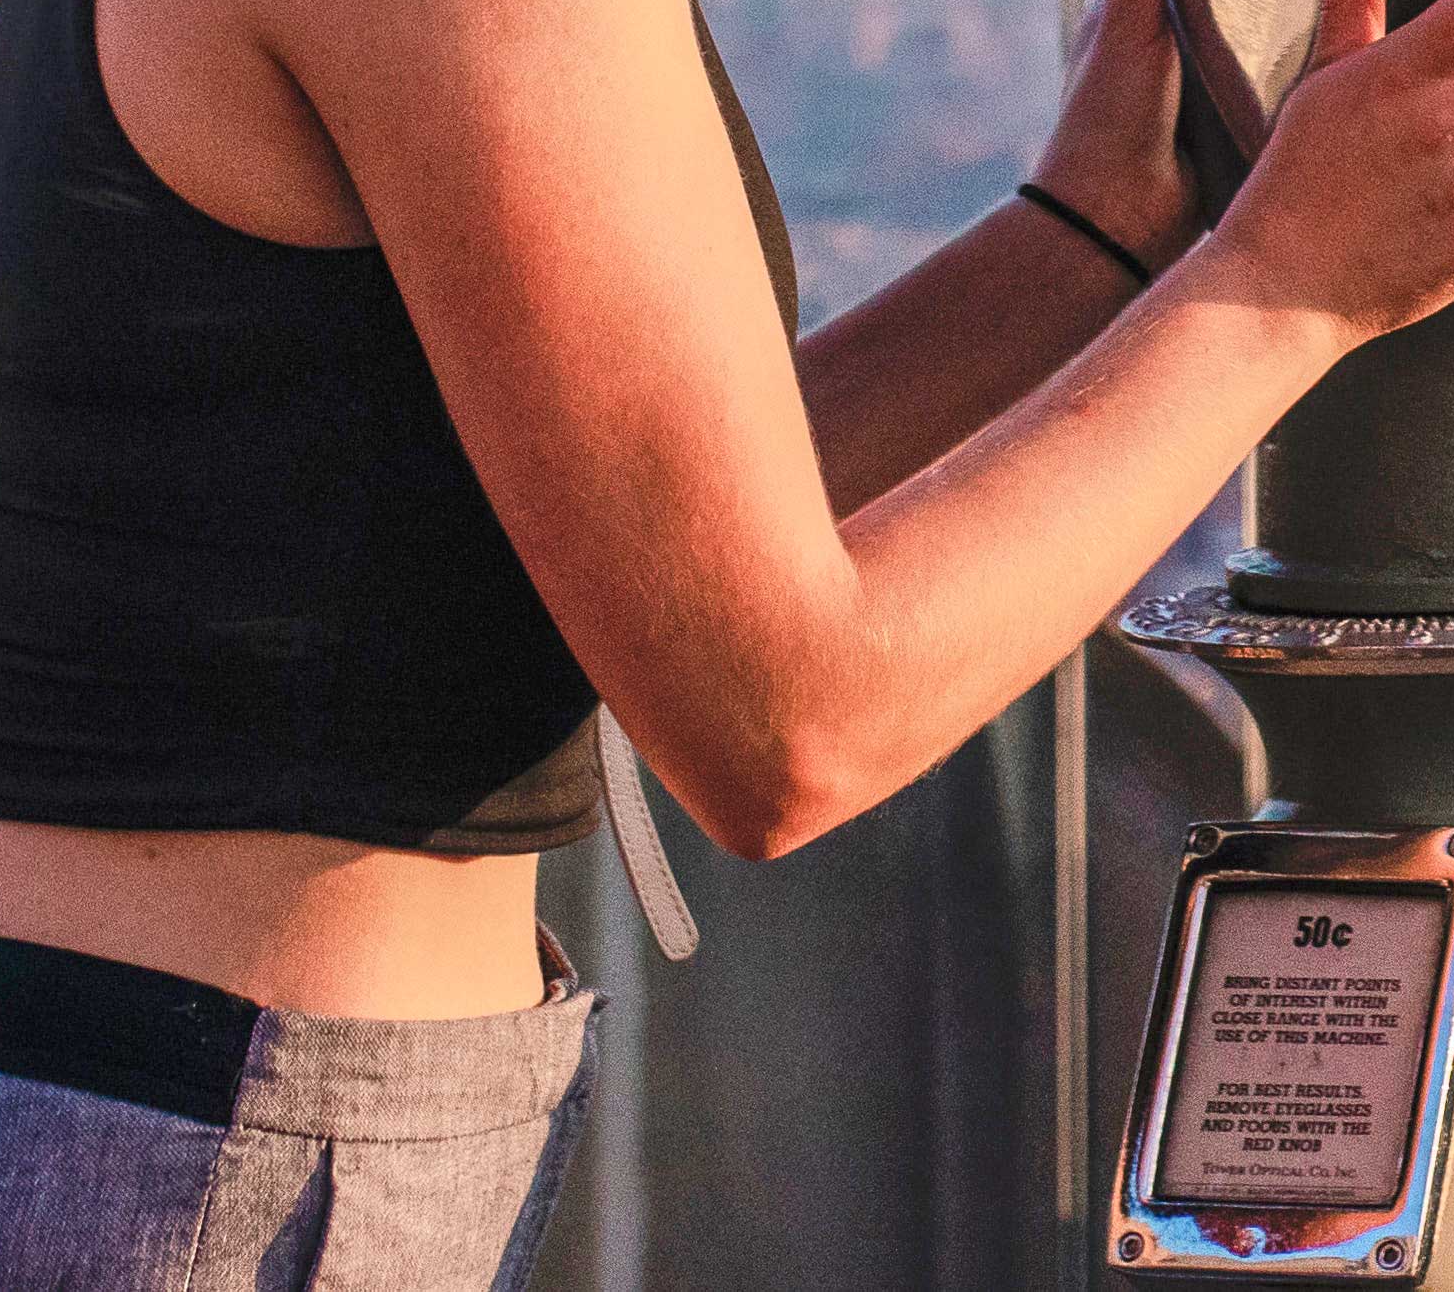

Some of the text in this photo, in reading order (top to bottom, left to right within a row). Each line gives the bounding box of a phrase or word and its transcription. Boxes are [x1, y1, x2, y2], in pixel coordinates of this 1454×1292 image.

[1223, 976, 1401, 992] BRING DISTANT POINTS
[1229, 994, 1389, 1009] OF INTEREST WITHIN
[1212, 1011, 1400, 1028] CLOSE RANGE WITH THE
[1214, 1029, 1245, 1042] USE
[1247, 1030, 1272, 1043] OF
[1275, 1031, 1308, 1044] THIS
[1218, 1083, 1250, 1096] FOR
[1254, 1083, 1292, 1097] BEST
[1205, 1101, 1372, 1117] REMOVE EYEGLASSES
[1200, 1119, 1372, 1135] AND FOCUS WITH THE
[1242, 1137, 1323, 1152] RED KNOB
